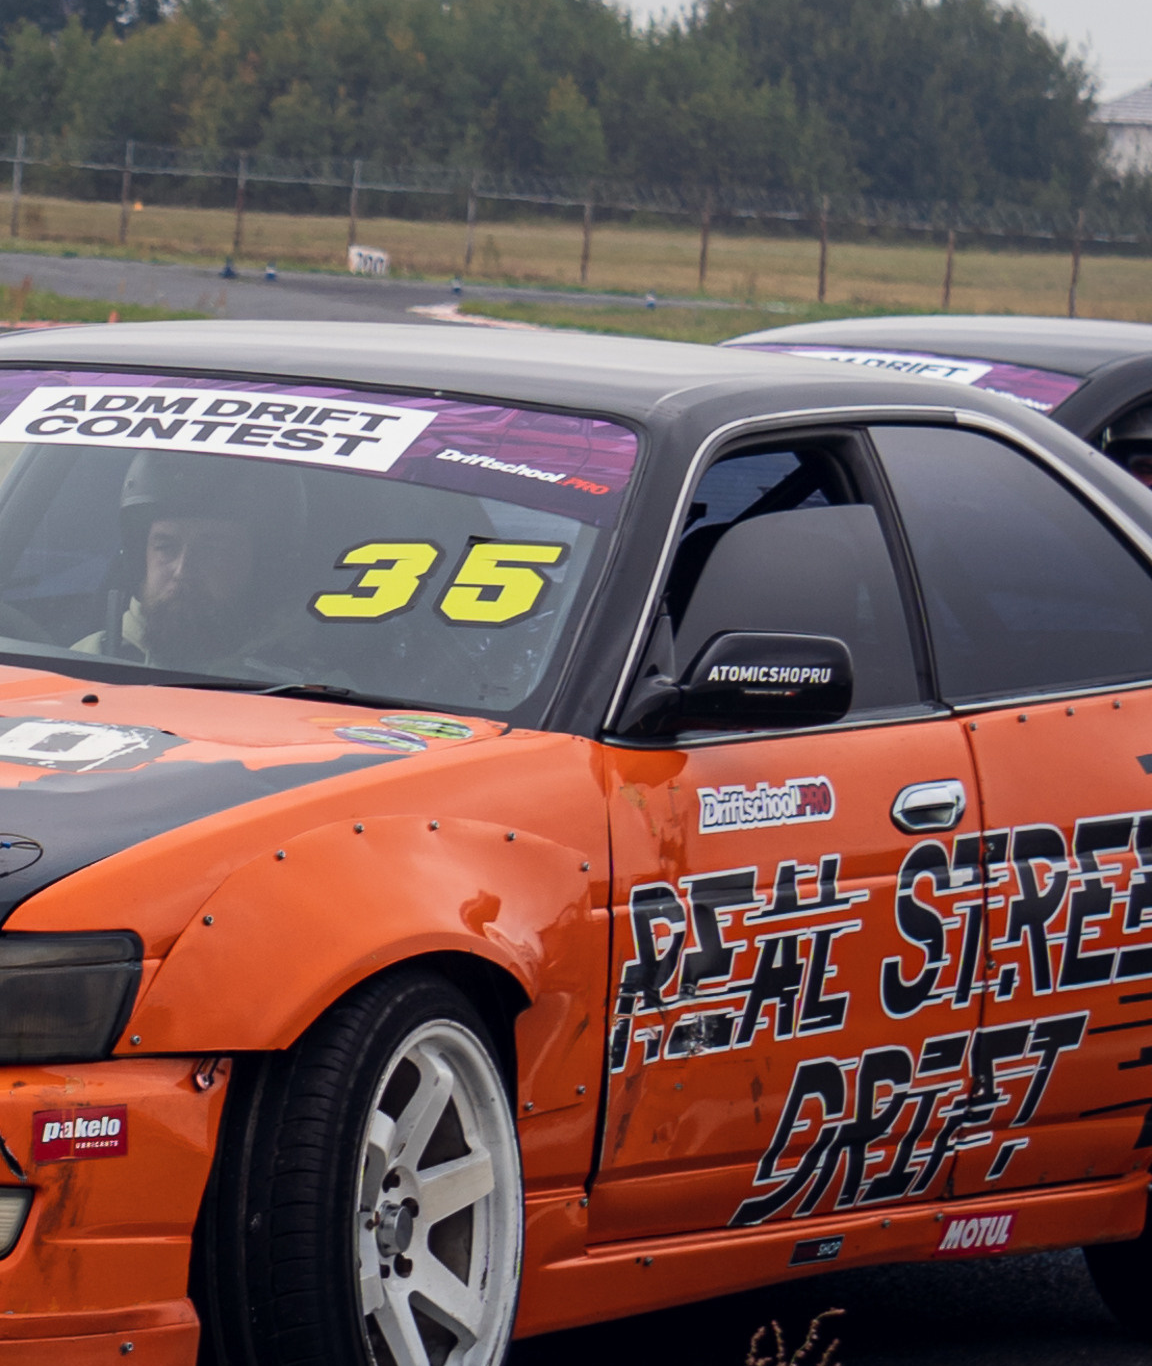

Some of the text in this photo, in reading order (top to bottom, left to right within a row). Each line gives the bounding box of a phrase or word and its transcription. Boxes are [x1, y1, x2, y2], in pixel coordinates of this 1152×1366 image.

[42, 394, 401, 432] ADM DRIFT
[25, 415, 382, 457] CONTEST
[312, 541, 565, 625] 35
[708, 665, 832, 684] ATOMICSHOPRU
[611, 853, 869, 1074] REAL
[42, 1116, 122, 1143] pakelo
[728, 1011, 1090, 1227] DRIFT
[939, 1214, 1014, 1251] MOTUL
